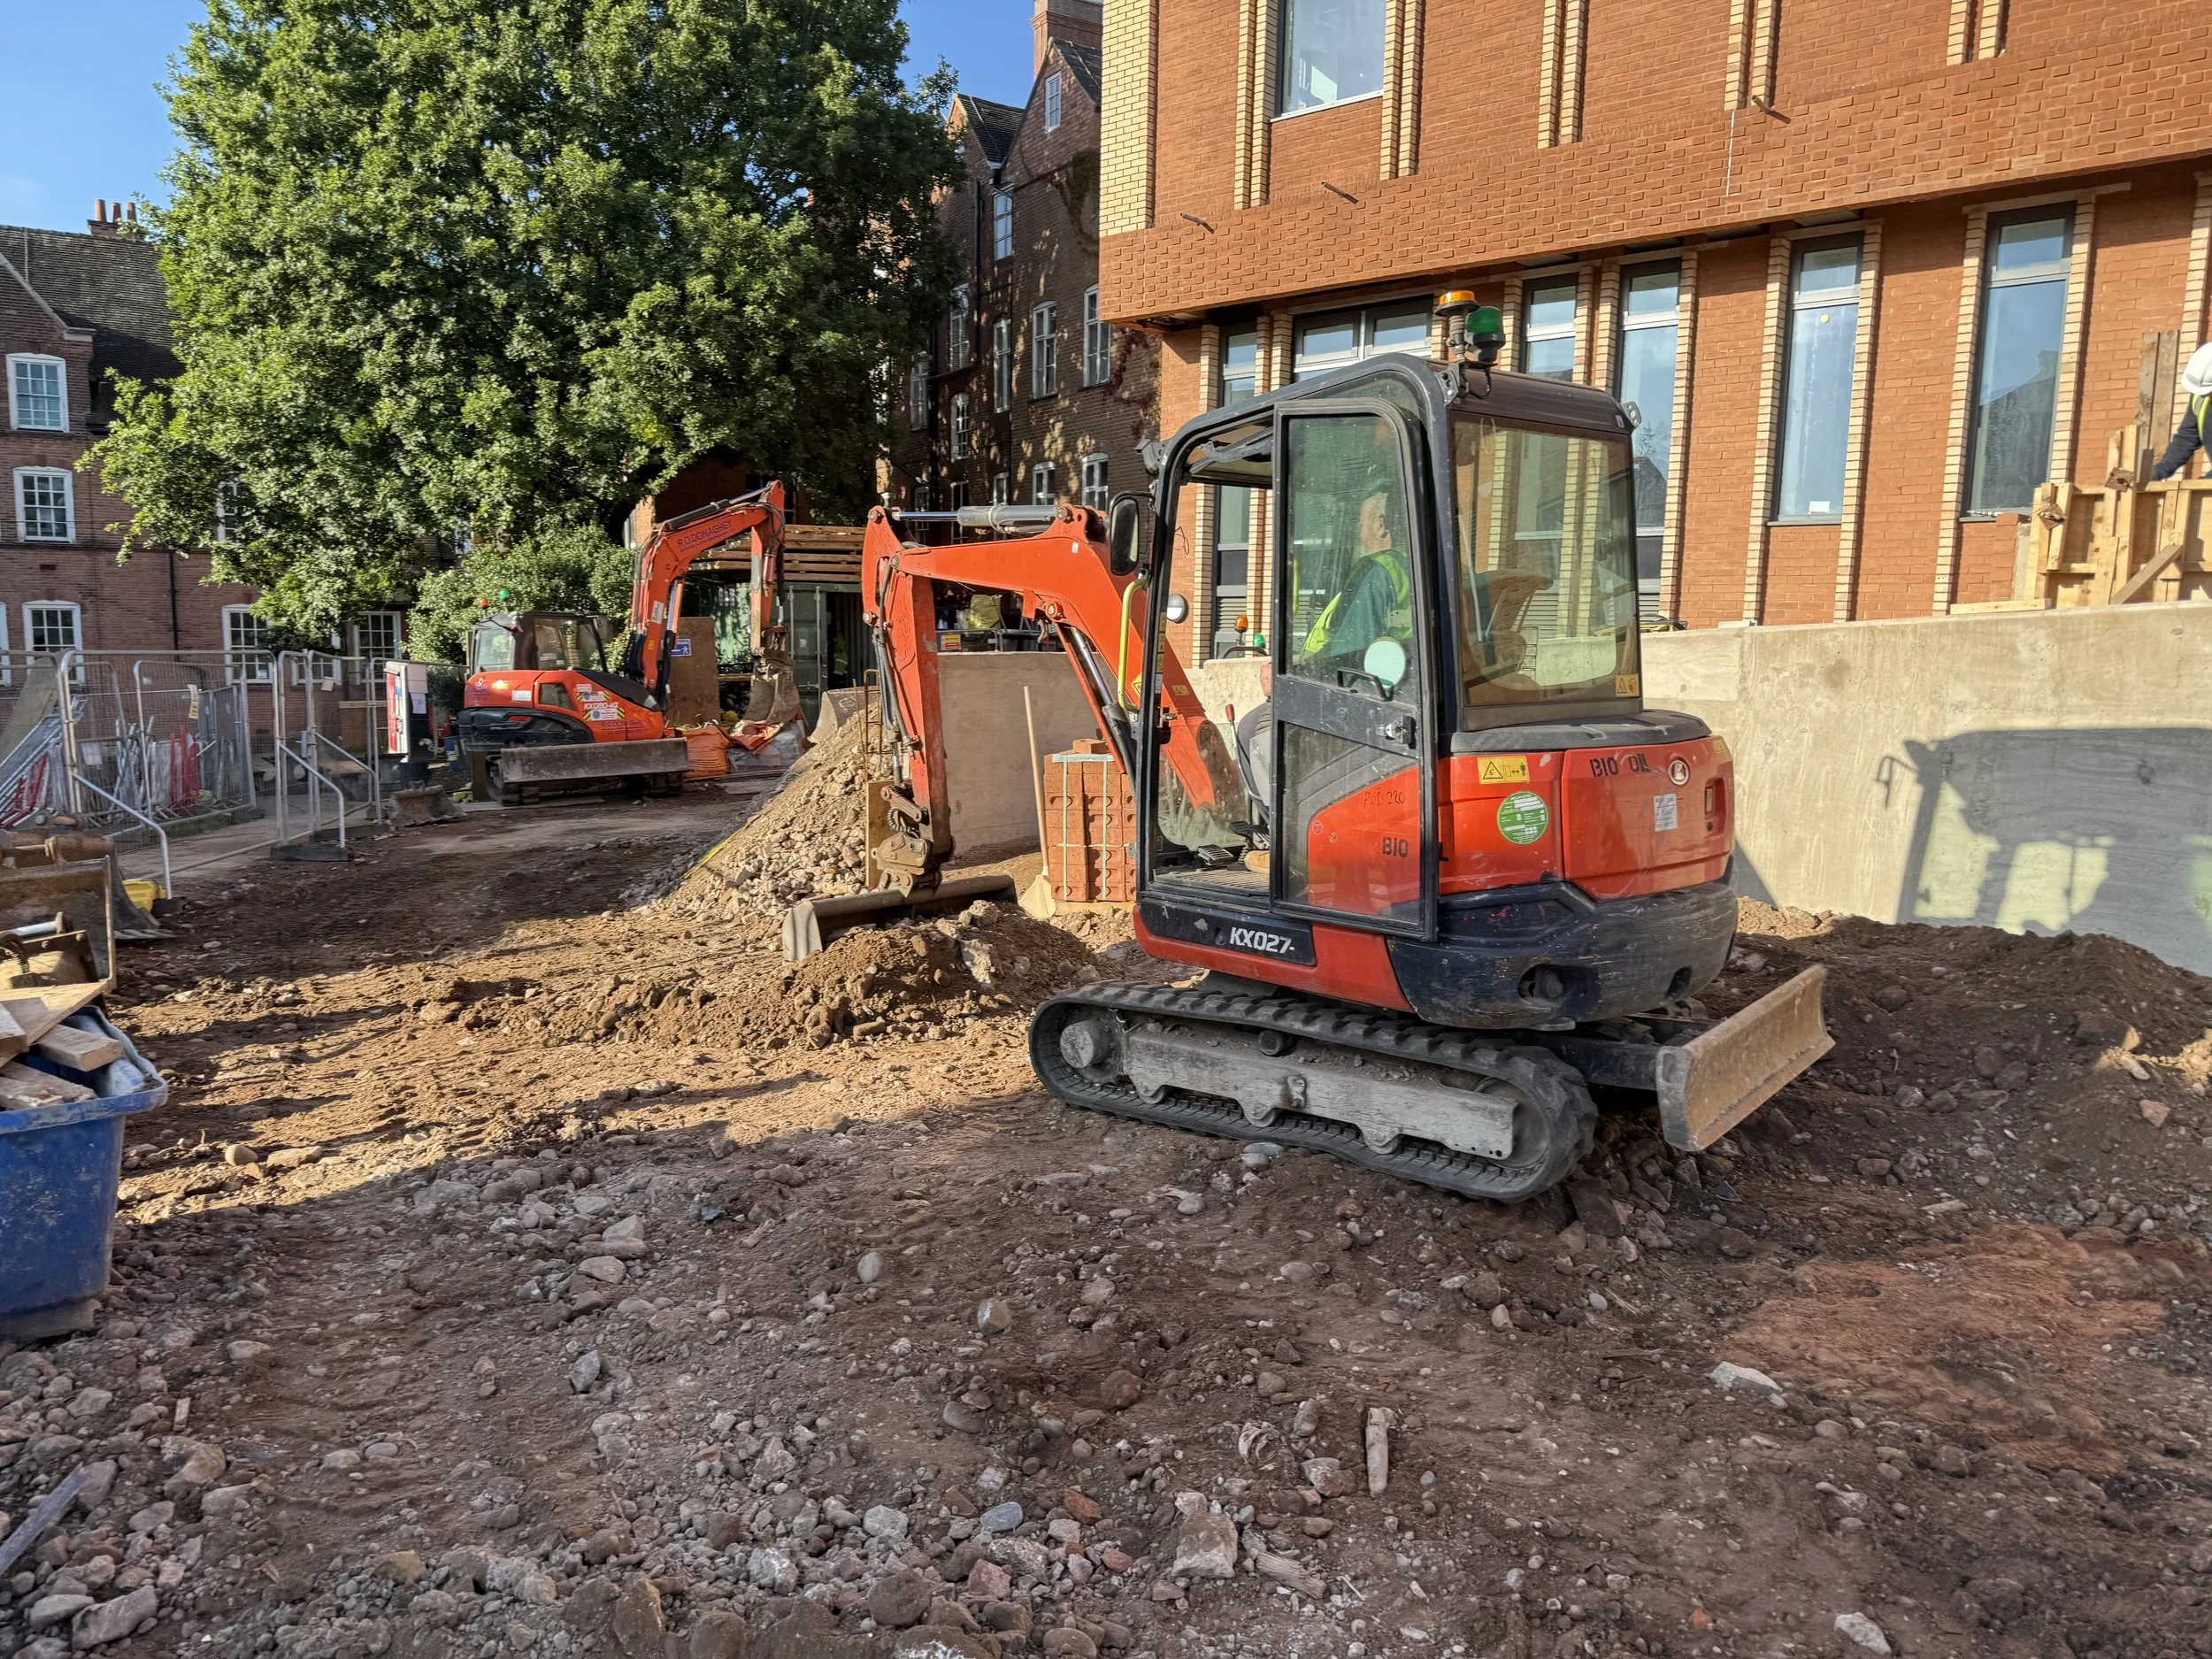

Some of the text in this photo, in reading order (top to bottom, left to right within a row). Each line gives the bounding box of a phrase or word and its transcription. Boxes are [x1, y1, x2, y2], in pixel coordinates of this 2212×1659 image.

[1589, 757, 1619, 778] BIO
[1386, 790, 1405, 805] 220
[1382, 836, 1409, 857] BIO
